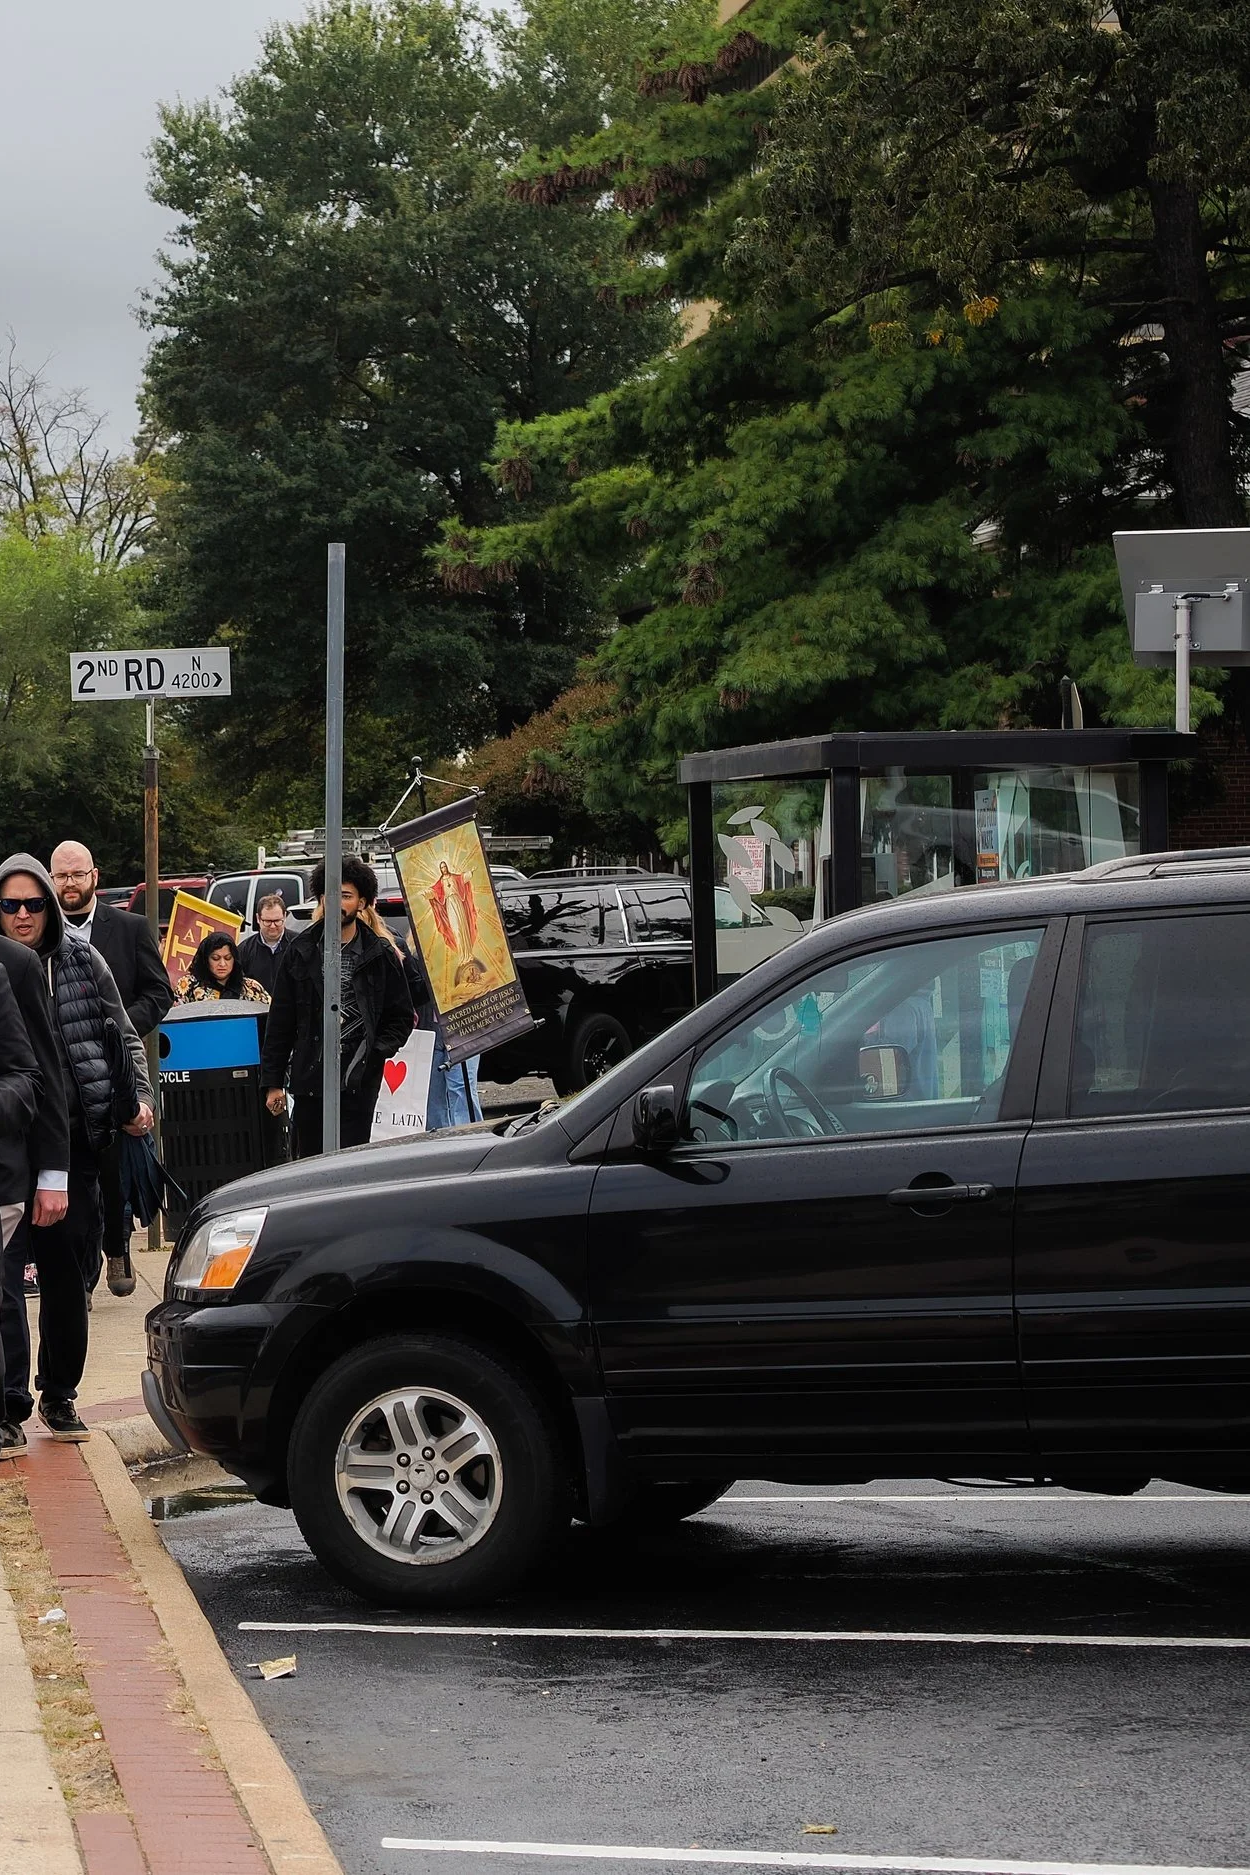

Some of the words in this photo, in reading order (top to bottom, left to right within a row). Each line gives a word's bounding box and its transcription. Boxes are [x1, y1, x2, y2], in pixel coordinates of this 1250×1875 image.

[192, 656, 201, 670] N
[124, 658, 165, 691] RD
[172, 673, 210, 689] 4200
[183, 930, 195, 942] A
[448, 1007, 471, 1022] SACRED
[472, 998, 490, 1012] HEART
[490, 995, 499, 1003] OF
[499, 987, 514, 1000] JESUS
[446, 1013, 479, 1033] SALVATION
[480, 1010, 487, 1018] OF
[488, 1004, 499, 1014] THE
[499, 994, 520, 1008] WORLD
[459, 1024, 476, 1036] HAVE
[477, 1016, 495, 1029] MERCY
[496, 1011, 505, 1020] ON
[506, 1007, 514, 1015] US
[159, 1071, 190, 1084] CYCLE
[391, 1113, 424, 1127] LATIN
